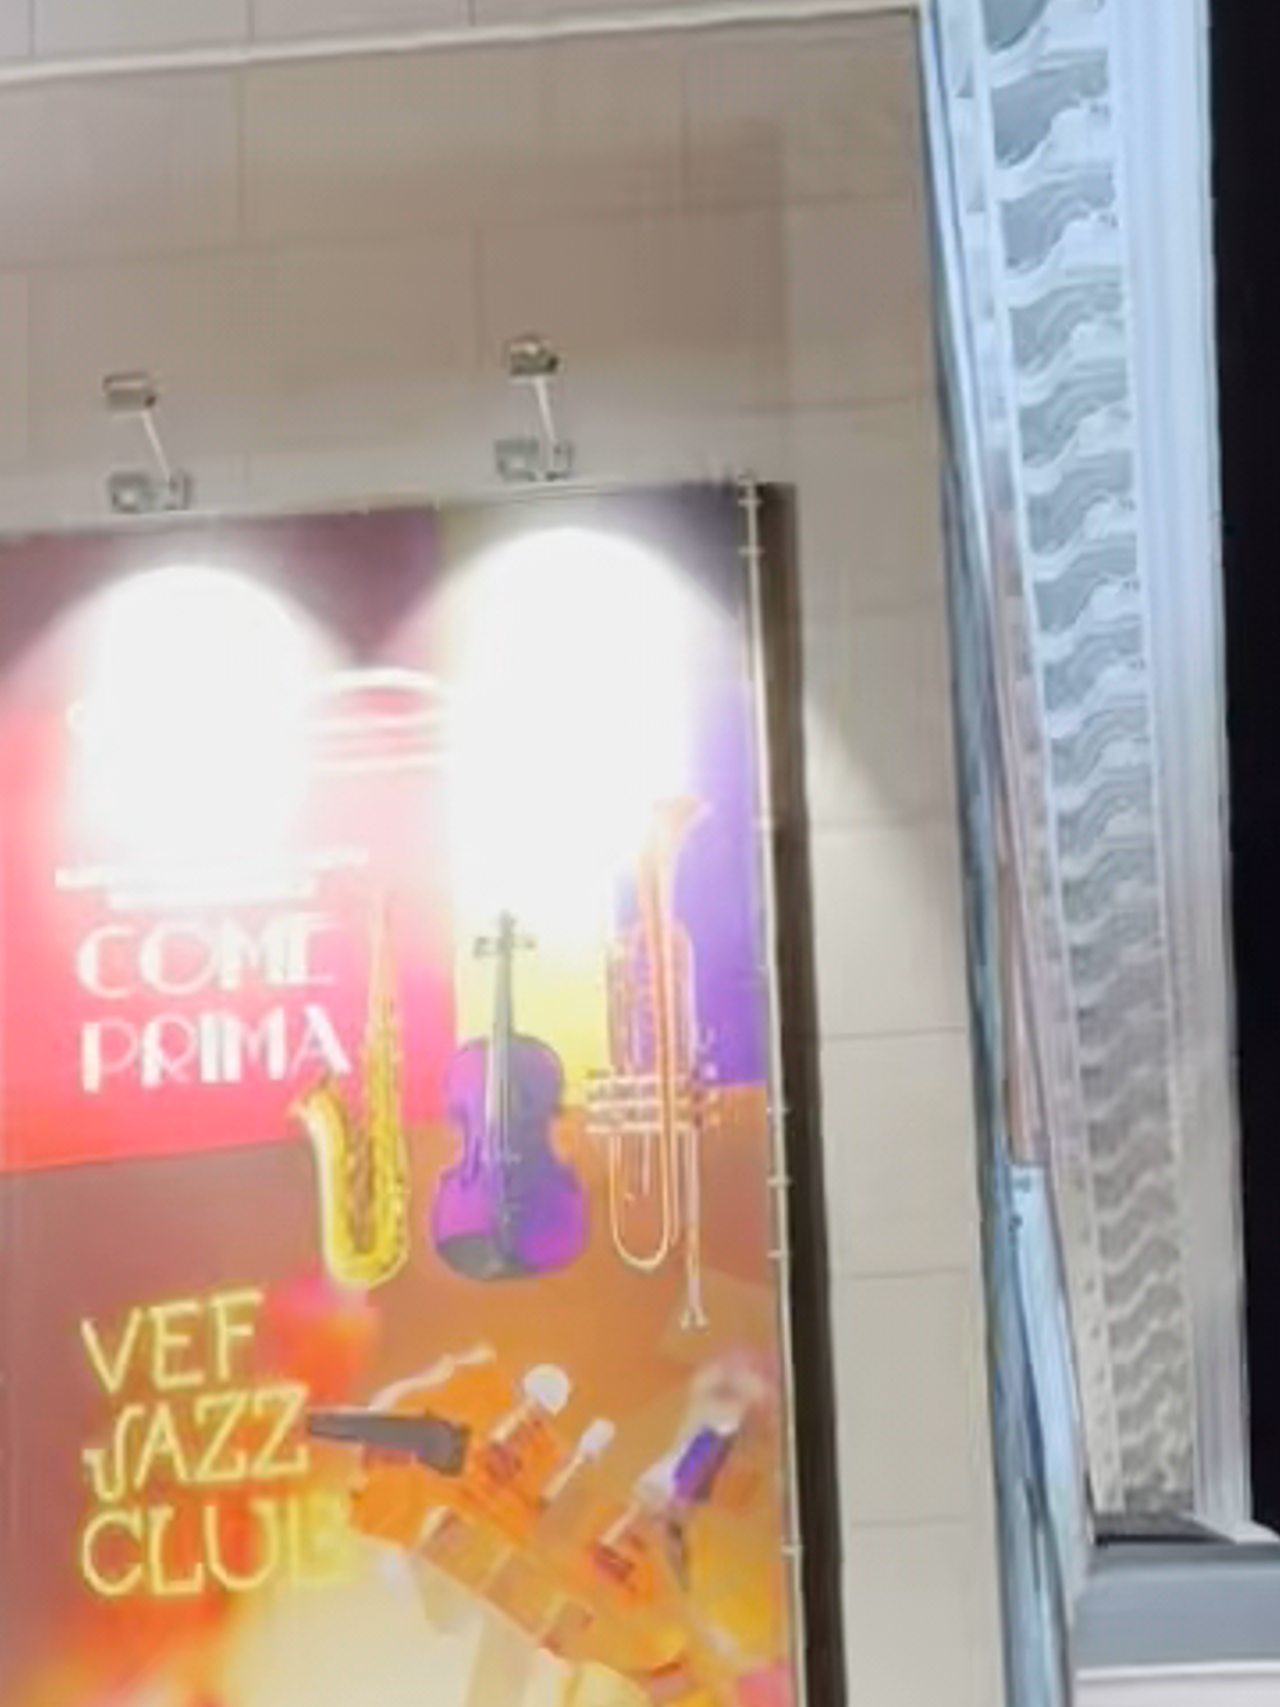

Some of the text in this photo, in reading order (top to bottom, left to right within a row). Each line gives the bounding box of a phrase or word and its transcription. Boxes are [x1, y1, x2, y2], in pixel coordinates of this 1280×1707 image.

[81, 1004, 352, 1092] PRIMA
[80, 1290, 264, 1395] VEF
[82, 1383, 310, 1500] JAZZ
